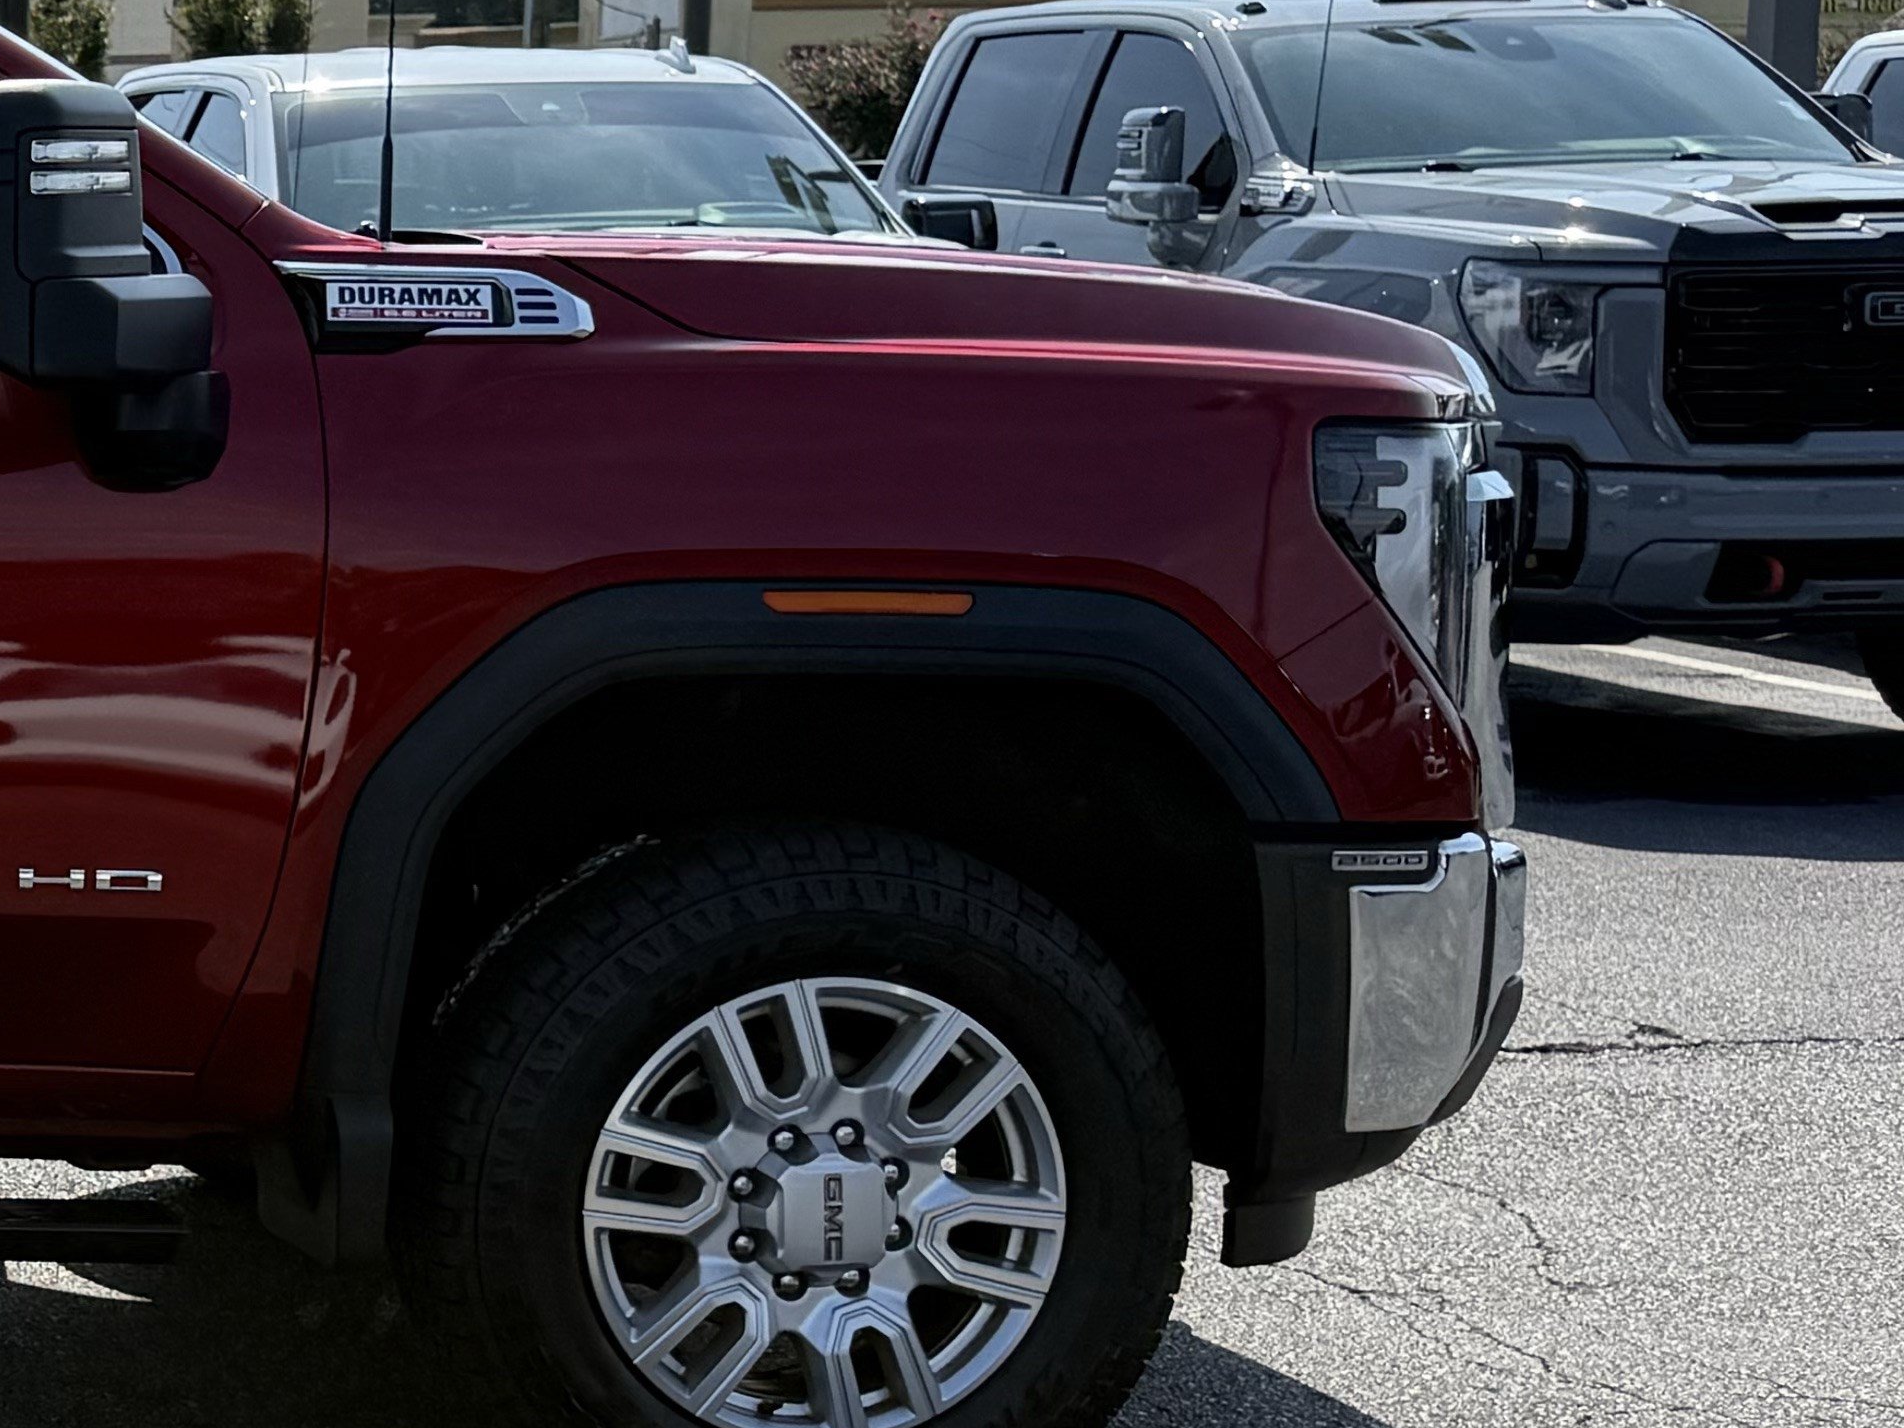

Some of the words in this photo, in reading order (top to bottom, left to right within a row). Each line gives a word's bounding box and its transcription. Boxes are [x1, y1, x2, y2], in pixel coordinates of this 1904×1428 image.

[338, 286, 482, 306] DURAMAX
[18, 866, 163, 891] HD
[824, 1173, 842, 1261] GMC
